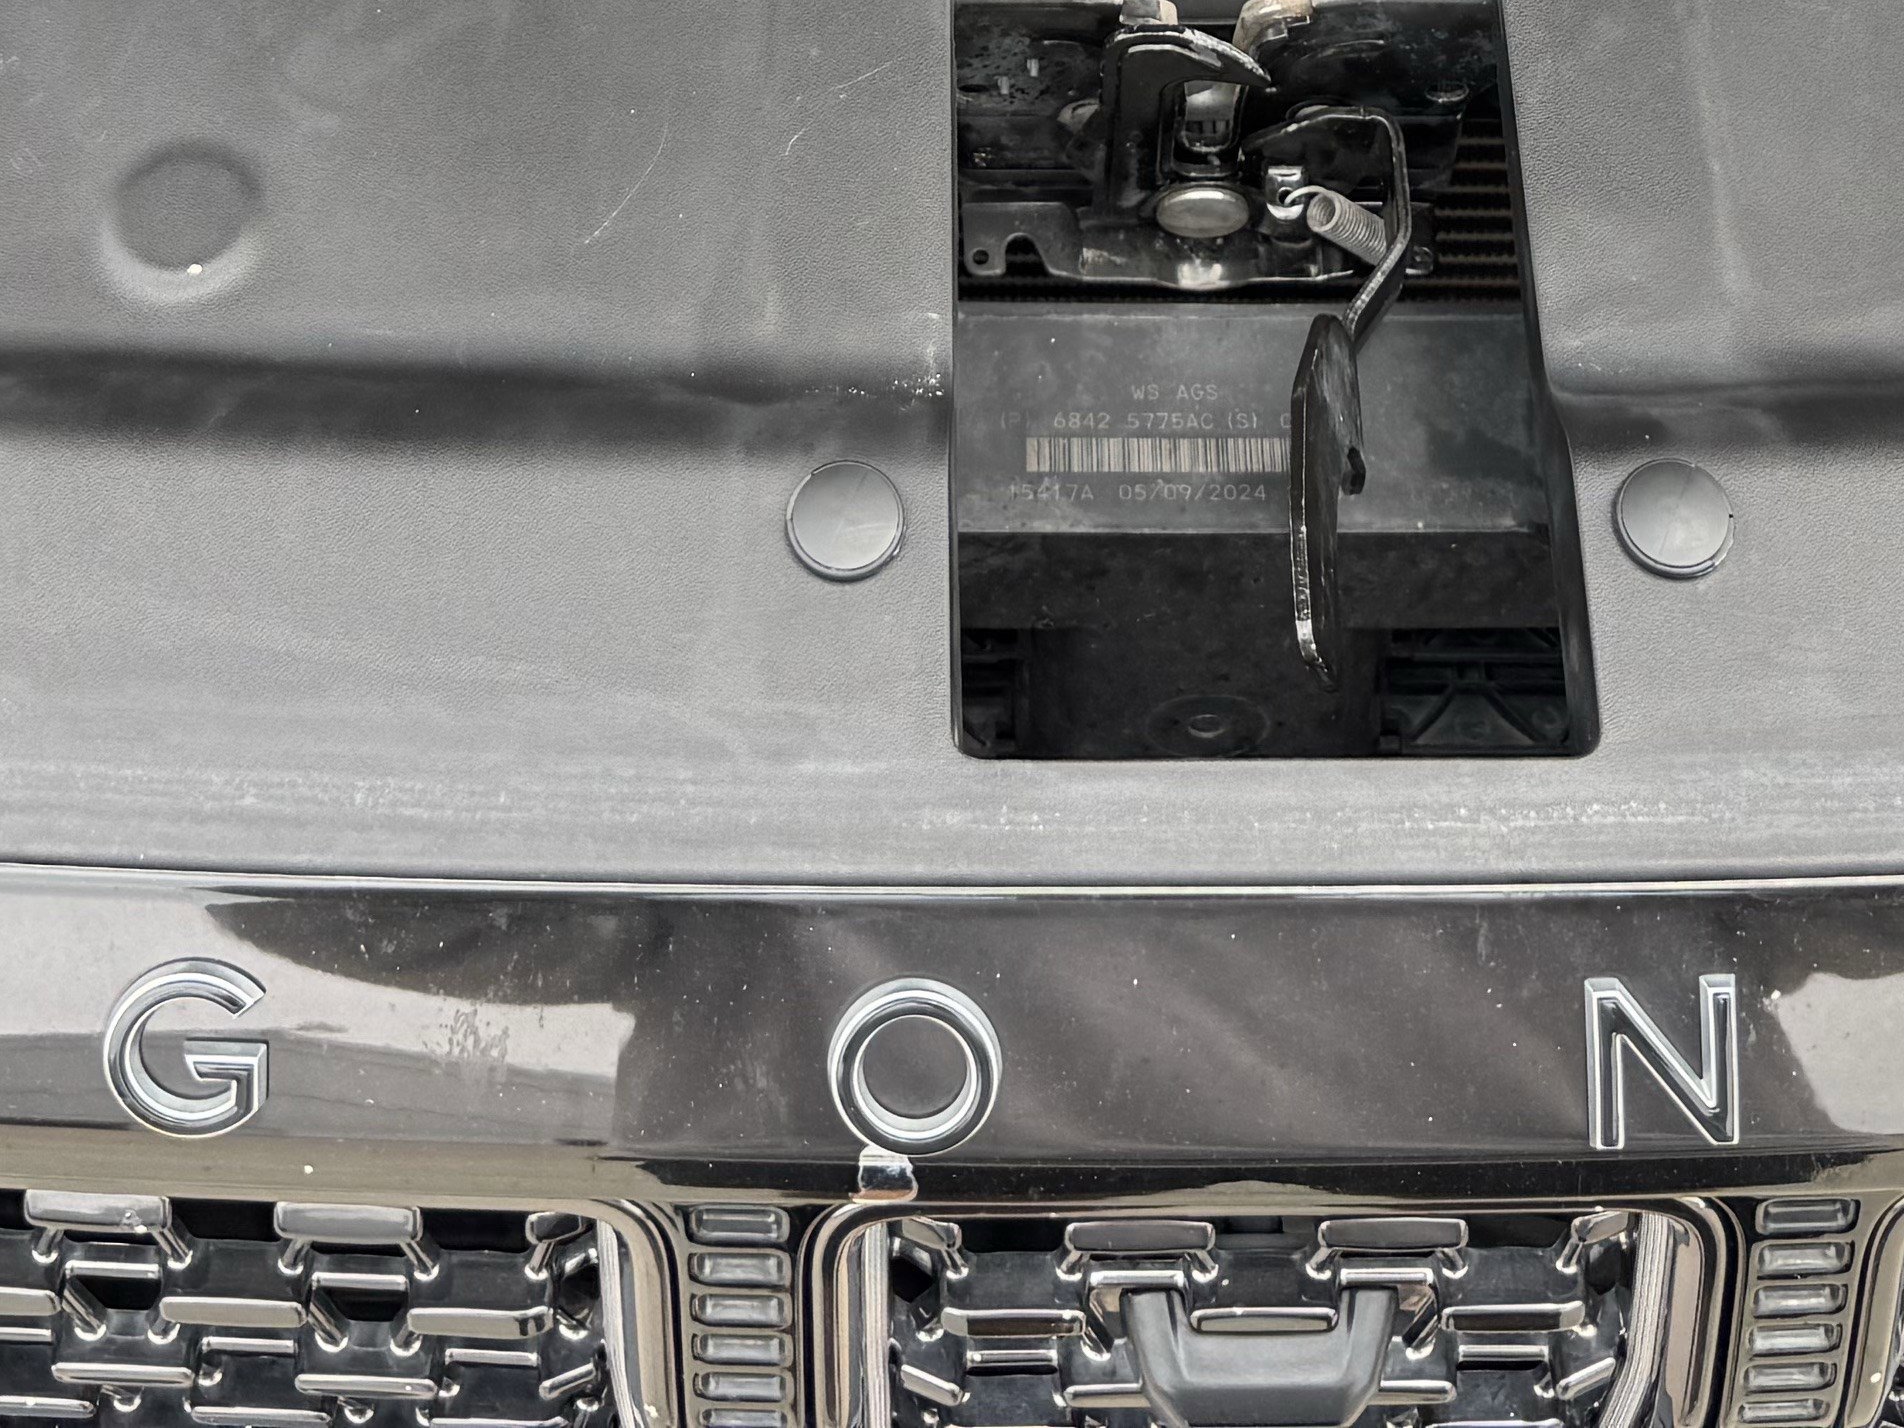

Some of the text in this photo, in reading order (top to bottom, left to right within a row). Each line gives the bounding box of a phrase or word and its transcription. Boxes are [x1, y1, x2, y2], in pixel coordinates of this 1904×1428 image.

[1131, 384, 1219, 401] WS AGS
[1053, 412, 1110, 430] 6842
[1126, 412, 1215, 430] 5775AC
[1118, 483, 1267, 502] 05/09/2024
